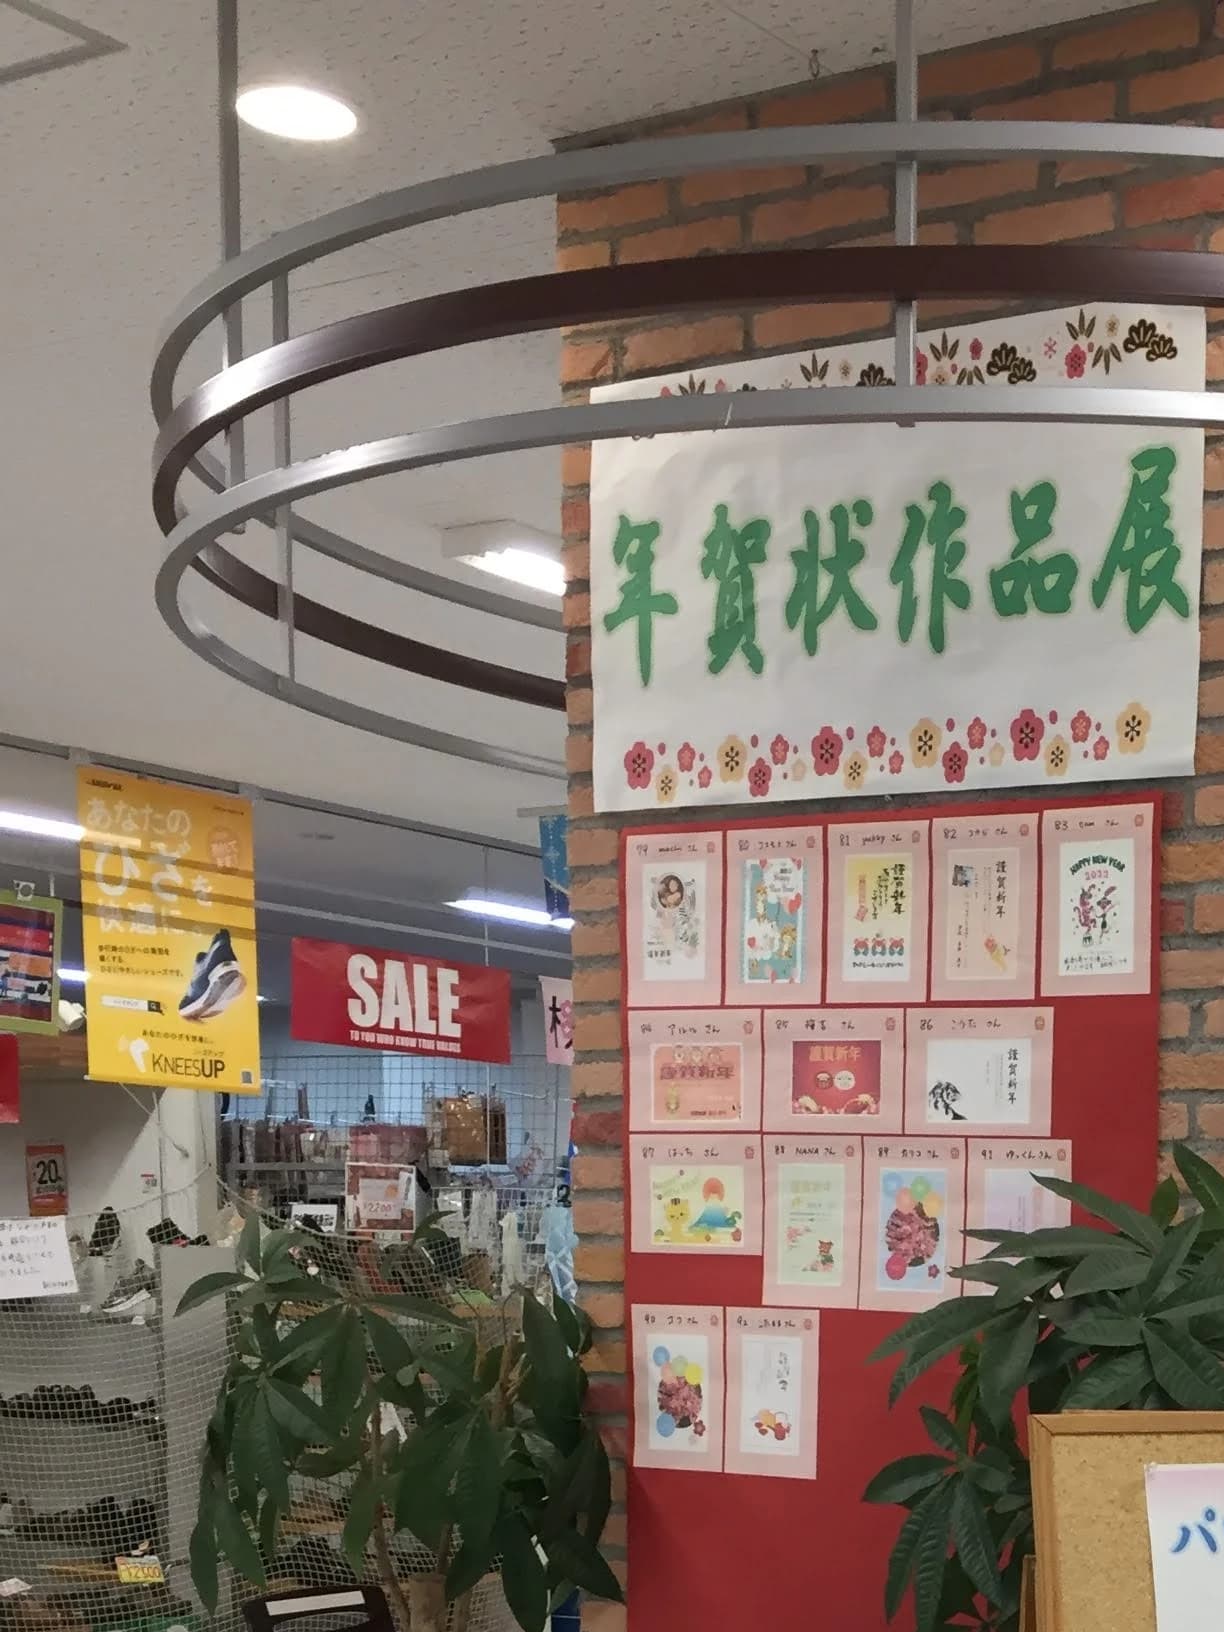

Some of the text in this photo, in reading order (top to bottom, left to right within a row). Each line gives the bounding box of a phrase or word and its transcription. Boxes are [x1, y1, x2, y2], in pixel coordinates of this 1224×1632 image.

[602, 445, 1192, 688] 年賀状作品展
[346, 953, 462, 1038] SALE
[152, 1053, 226, 1079] KNEESUP
